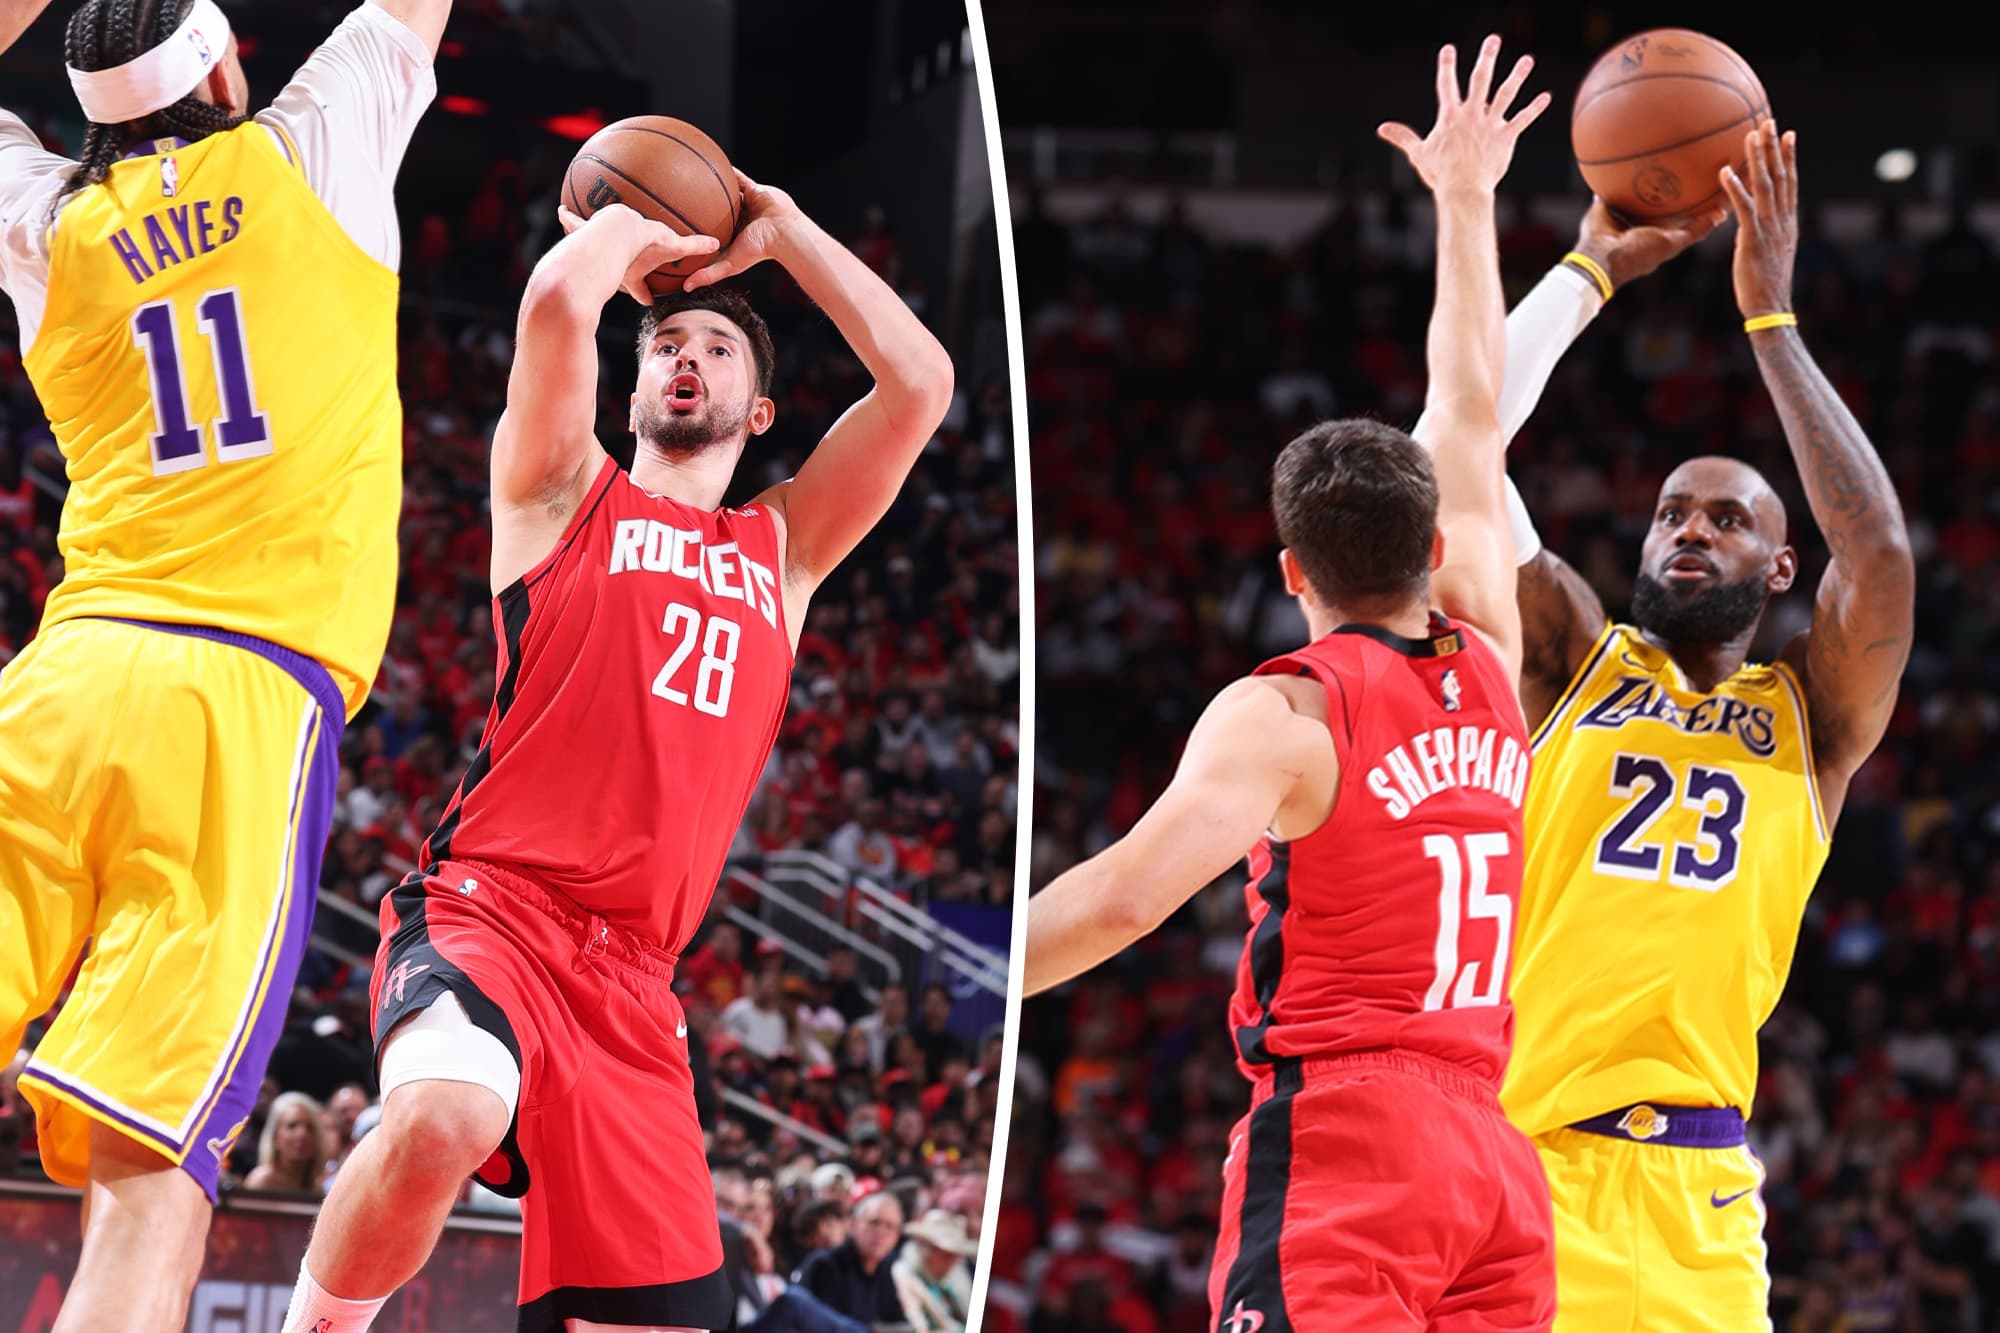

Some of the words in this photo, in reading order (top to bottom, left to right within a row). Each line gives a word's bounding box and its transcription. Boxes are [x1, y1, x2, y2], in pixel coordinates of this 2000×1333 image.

[110, 197, 243, 284] HAYES
[131, 286, 274, 476] 11
[652, 602, 741, 717] 28
[1367, 726, 1529, 819] SHEPPARD
[1593, 752, 1747, 892] 23
[1424, 833, 1513, 1011] 15
